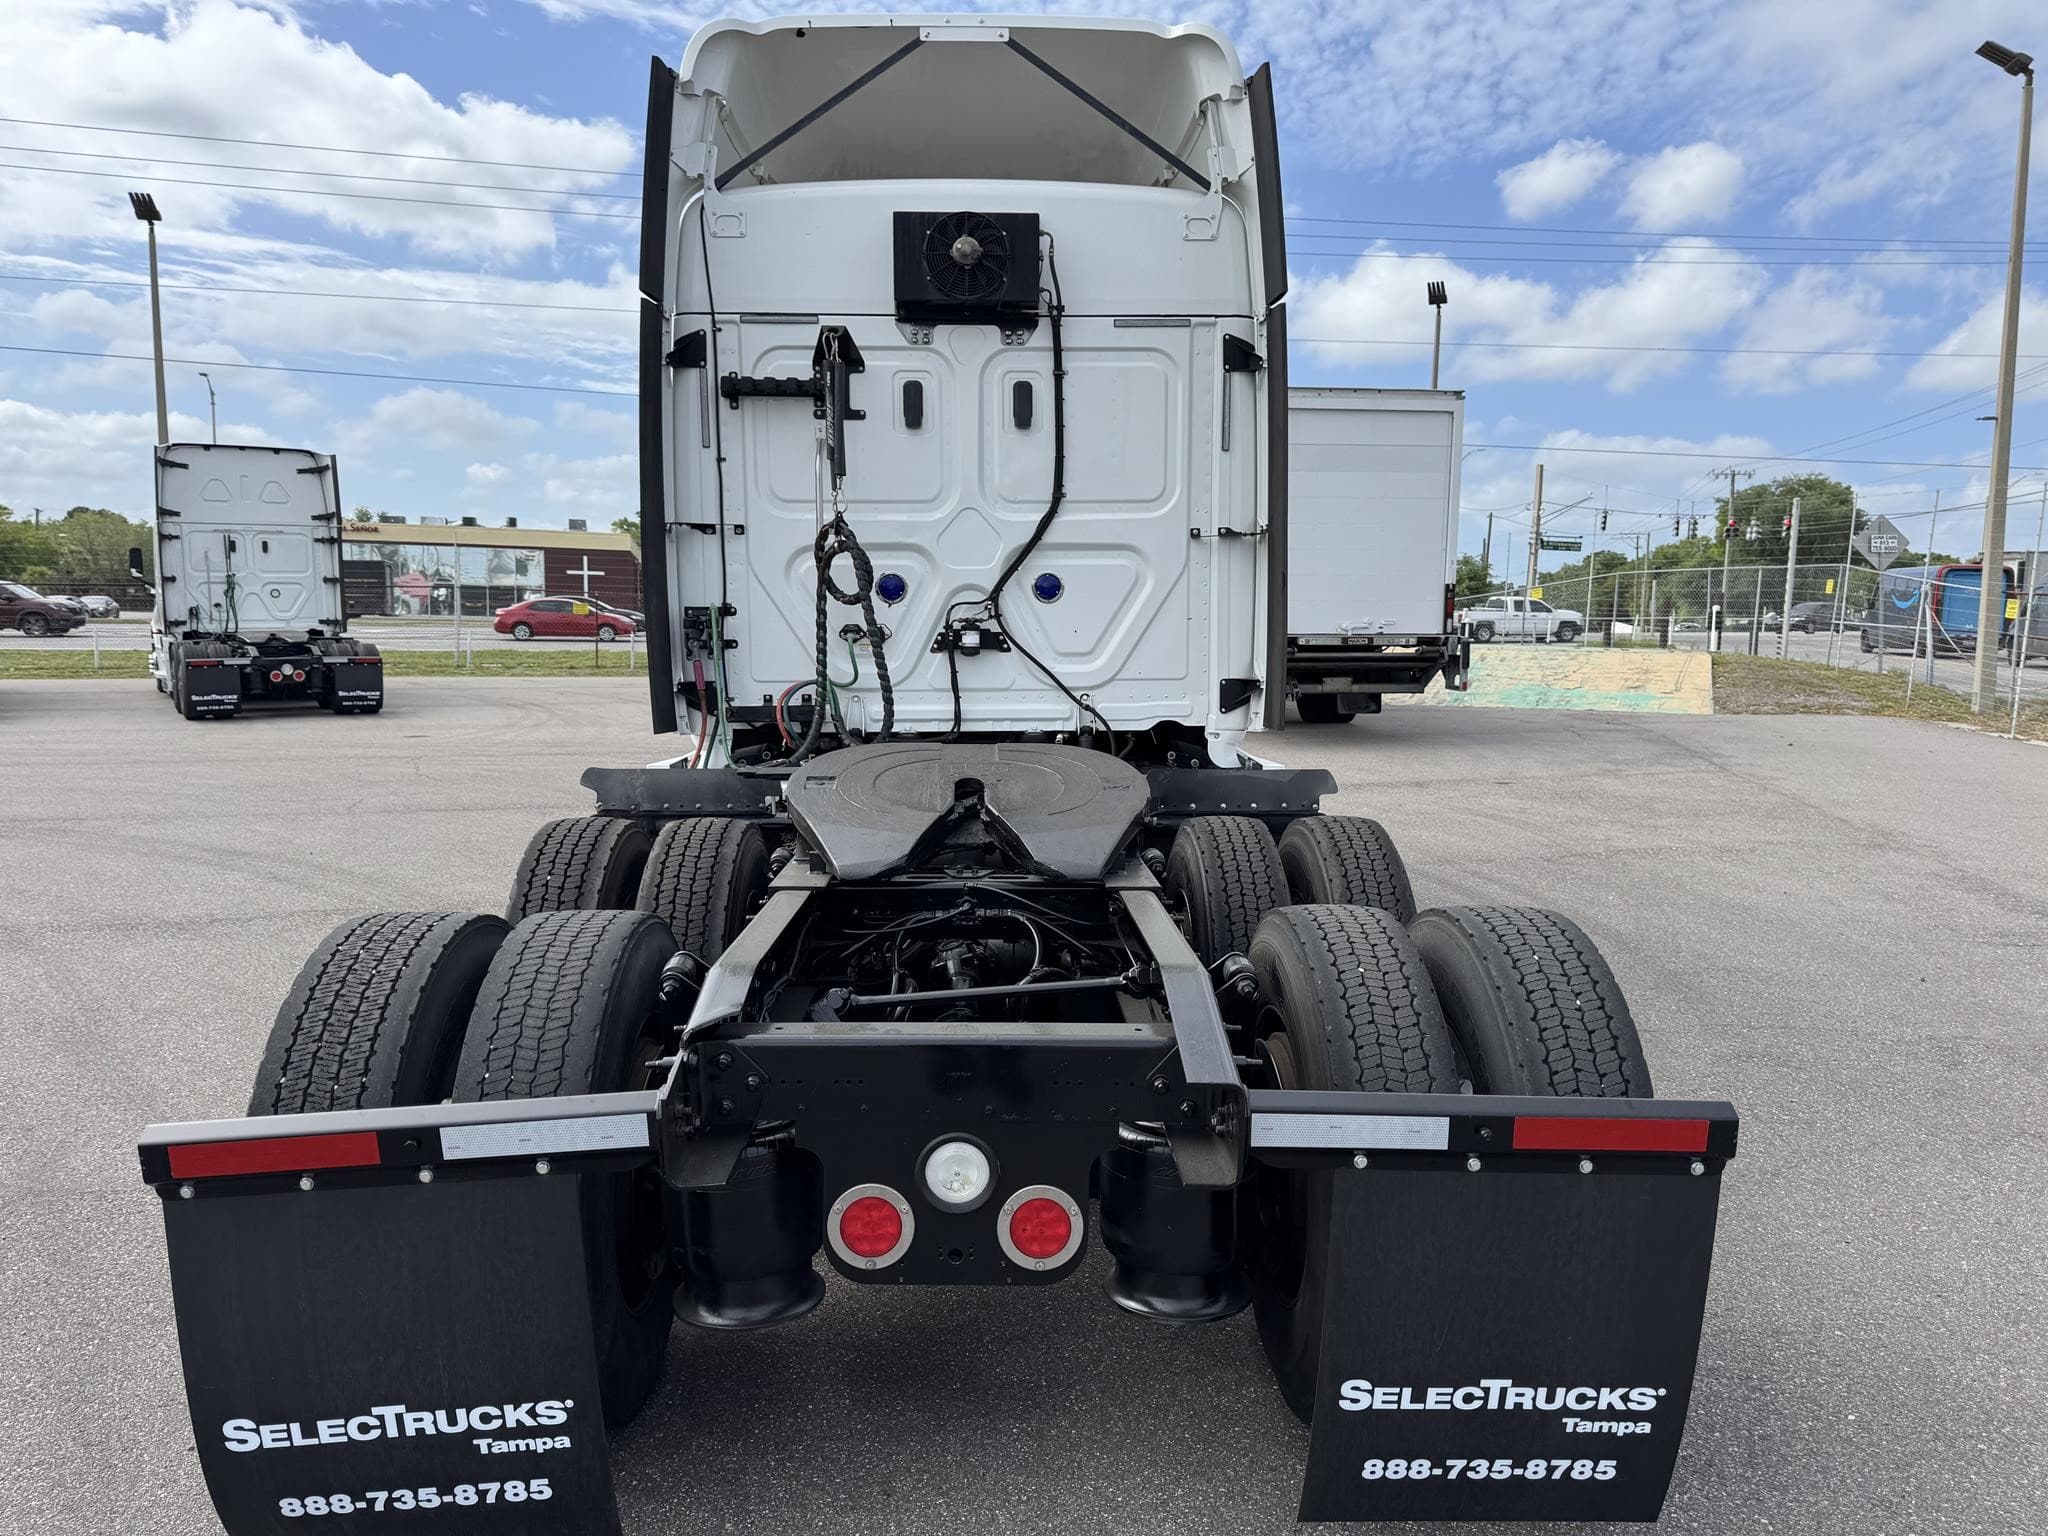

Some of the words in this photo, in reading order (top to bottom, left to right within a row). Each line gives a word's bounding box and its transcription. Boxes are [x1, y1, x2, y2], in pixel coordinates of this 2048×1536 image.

[1561, 1417, 1652, 1437] Tampa
[472, 1434, 572, 1456] Tampa
[1361, 1458, 1617, 1480] 888-735-8785
[278, 1478, 553, 1518] 888-735-8785
